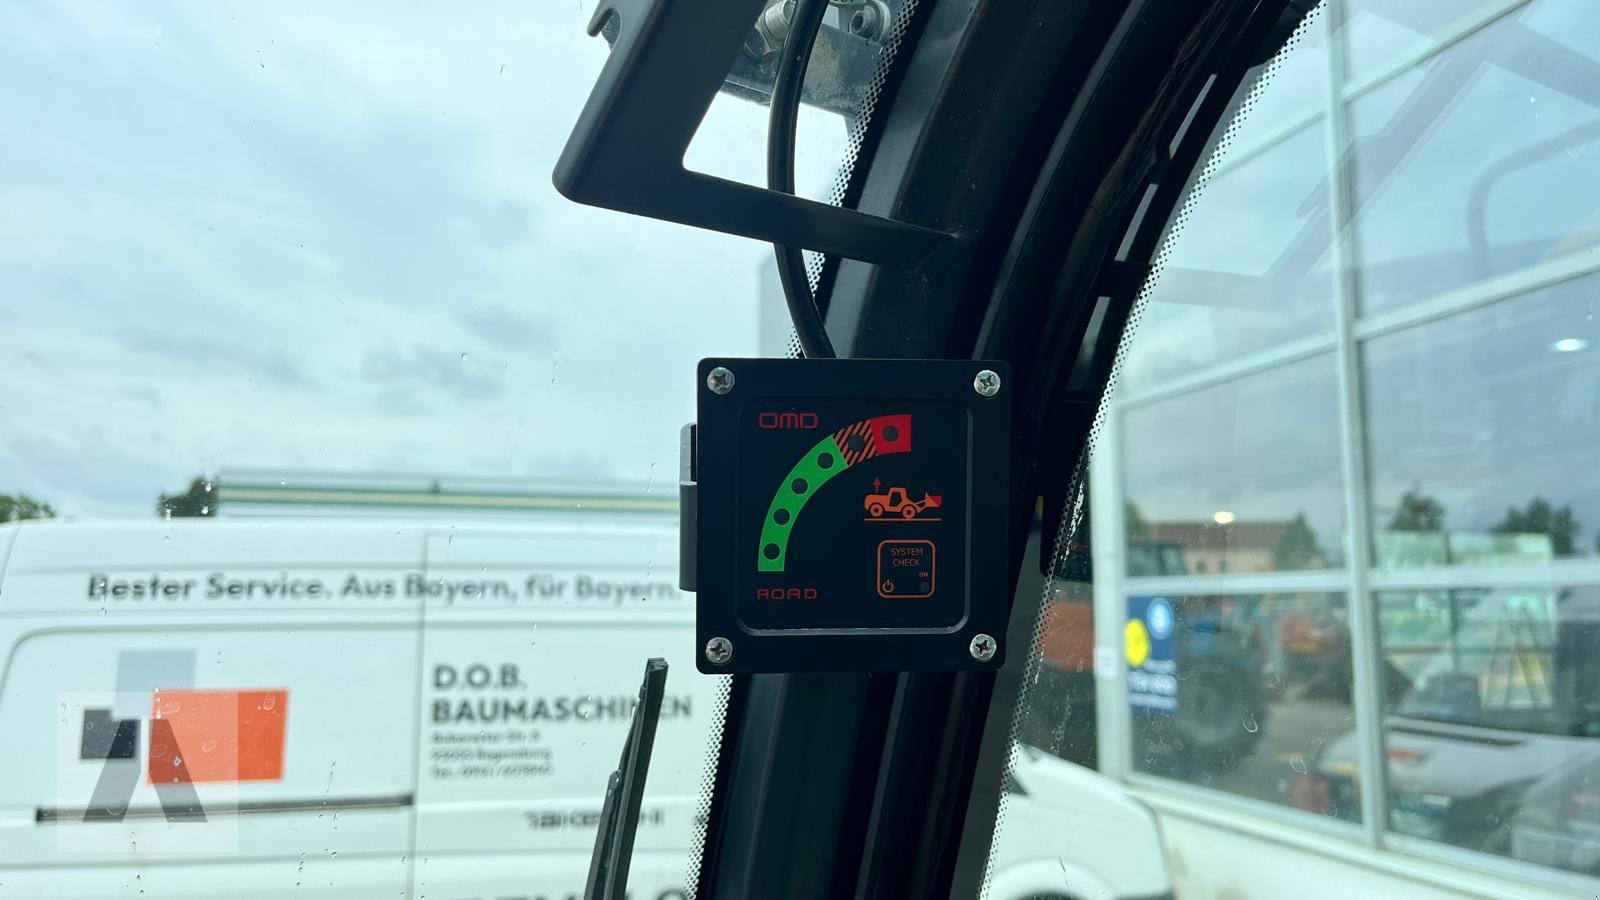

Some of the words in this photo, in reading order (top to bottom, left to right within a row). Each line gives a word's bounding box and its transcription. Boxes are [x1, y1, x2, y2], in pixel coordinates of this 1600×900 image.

[758, 412, 819, 429] OMD
[890, 547, 924, 556] SYSTEM
[892, 558, 920, 567] CHECK
[88, 572, 196, 602] Bester
[340, 572, 396, 601] Aus
[524, 573, 566, 599] für
[756, 588, 817, 600] ROAD
[431, 663, 527, 691] D.O.B.
